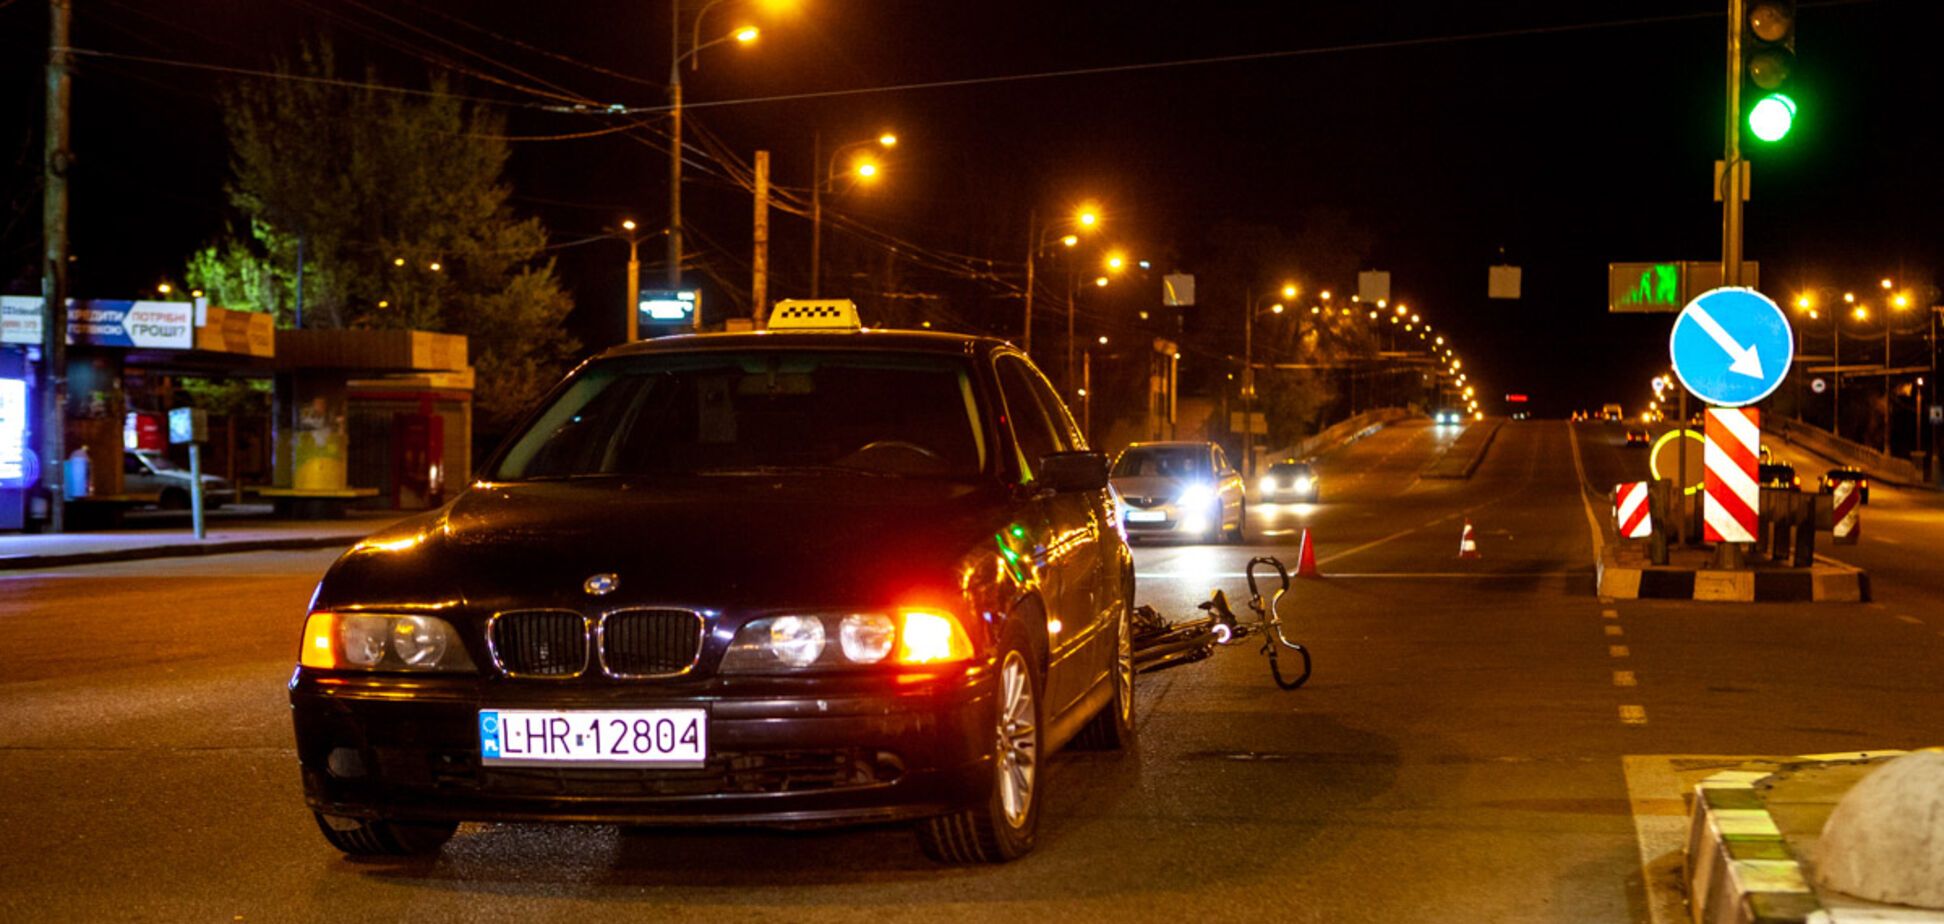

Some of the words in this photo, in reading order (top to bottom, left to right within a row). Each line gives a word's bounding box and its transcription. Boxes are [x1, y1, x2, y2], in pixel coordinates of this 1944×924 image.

[68, 310, 124, 322] КРЕДИТИ
[132, 312, 186, 322] ПОТРІБНІ
[132, 324, 186, 337] ГРОШІ?
[503, 718, 570, 753] LHR
[589, 718, 698, 754] 12804
